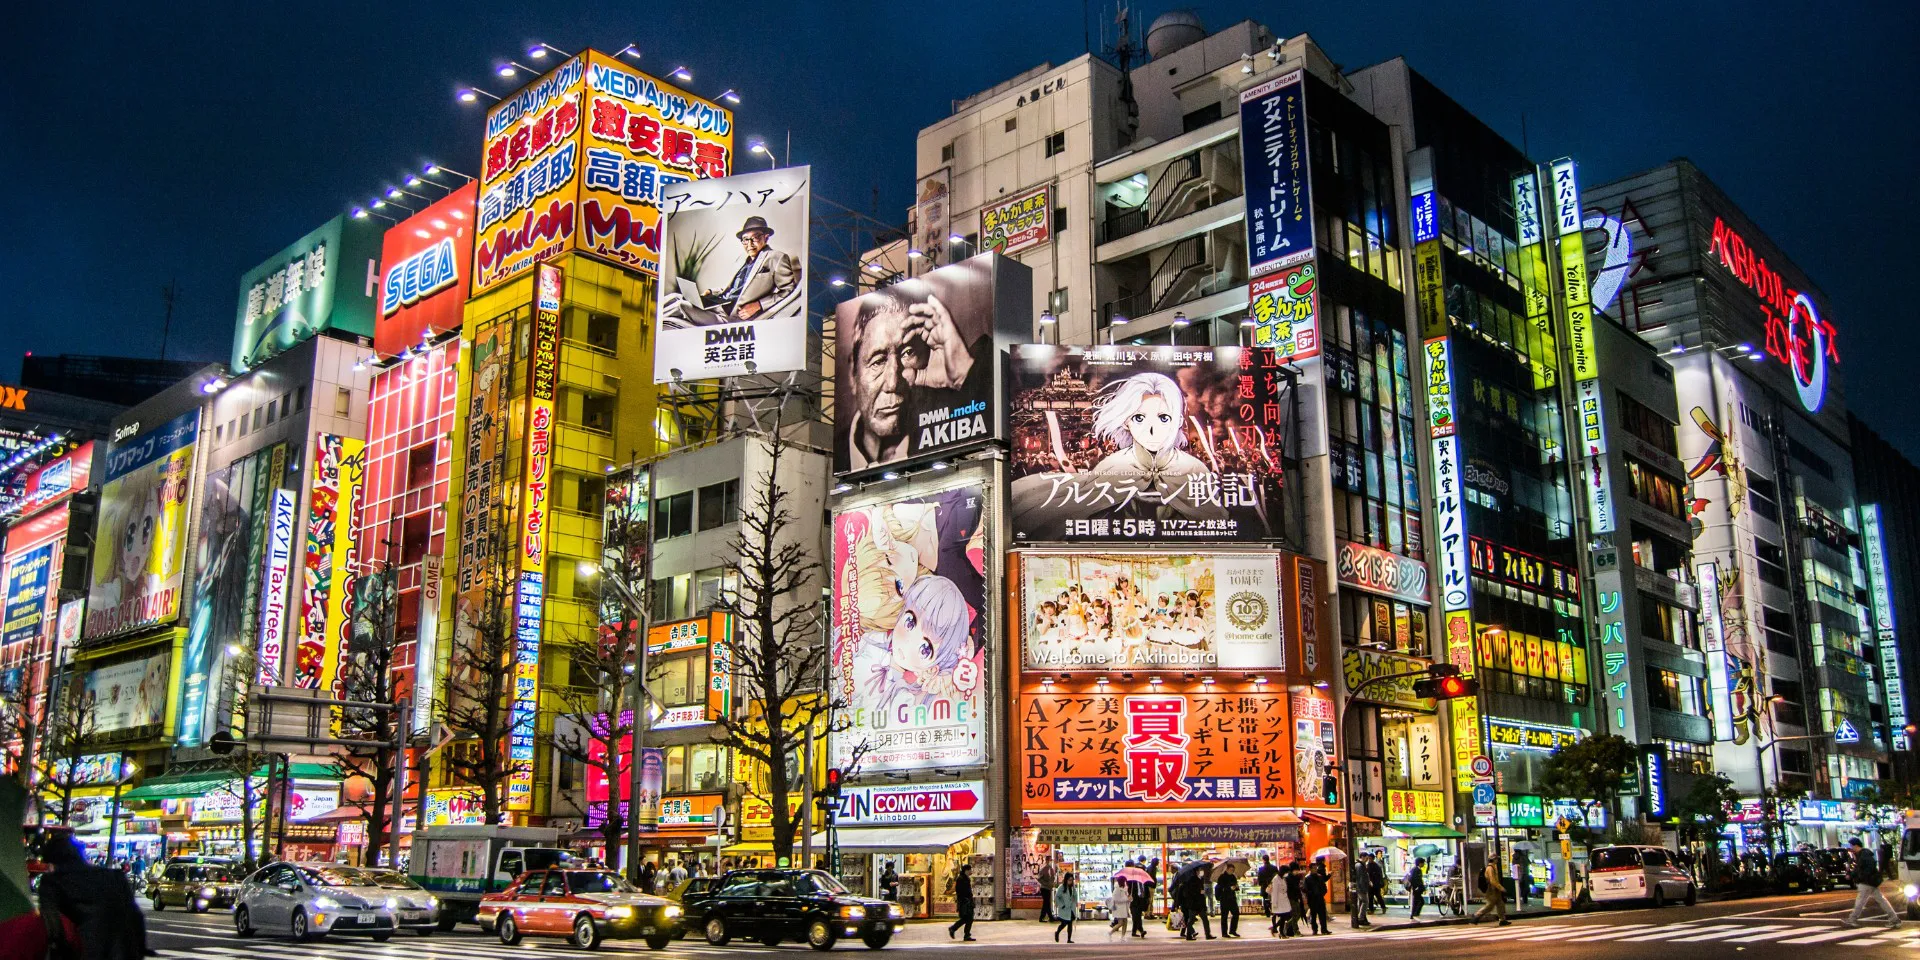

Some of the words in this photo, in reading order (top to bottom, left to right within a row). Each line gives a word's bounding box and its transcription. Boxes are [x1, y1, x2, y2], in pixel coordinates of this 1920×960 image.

[489, 57, 584, 139] MEDIAリサイクル
[593, 65, 729, 134] MEDIAリサイクル
[1243, 83, 1271, 100] AMENITY
[1274, 73, 1298, 89] DREAM
[485, 100, 579, 182] 激安販売
[592, 98, 727, 180] 激安販売
[480, 143, 575, 233] 高額買取
[1262, 95, 1291, 252] アメニティードリーム
[984, 192, 1046, 232] まんが喫茶
[1557, 169, 1576, 228] スーパービル
[511, 251, 533, 272] AKIBA
[597, 243, 641, 267] ムーラン
[1254, 260, 1283, 275] AMENITY
[1286, 252, 1311, 265] DREAM
[383, 237, 459, 315] SEGA
[1566, 264, 1579, 302] Yellow
[540, 311, 557, 323] DVD
[1253, 293, 1314, 323] まんが
[540, 341, 553, 351] CD
[705, 325, 756, 346] DMM
[1255, 321, 1292, 345] 喫茶
[1299, 337, 1314, 349] 3F
[1572, 311, 1587, 373] Submarine
[704, 343, 755, 364] 英会話
[1428, 341, 1446, 385] まんが
[1581, 380, 1593, 390] 5F
[919, 399, 986, 427] DMM.make
[918, 414, 988, 450] AKIBA
[1039, 471, 1258, 513] アルスラーン戦記
[1346, 464, 1362, 487] 5F
[246, 454, 268, 581] メロンブックス
[276, 493, 292, 549] AKKY
[1075, 519, 1110, 536] 日曜
[1123, 519, 1156, 536] 5時
[1161, 519, 1238, 530] TVアニメ放送中
[426, 560, 439, 600] GAME
[1338, 545, 1428, 597] メイドカジノ
[1503, 551, 1545, 588] フィギュア
[133, 596, 151, 622] ON
[151, 587, 176, 620] AIR!
[265, 564, 287, 640] Tax-free
[1255, 632, 1273, 640] cafe
[1032, 649, 1107, 665] Welcome
[1111, 650, 1128, 665] to
[1132, 648, 1218, 665] Akihabara
[1307, 645, 1314, 666] 入口
[1600, 591, 1628, 728] リバティー
[897, 695, 978, 726] GAME!
[1076, 698, 1097, 753] アニメ
[1214, 697, 1236, 753] ホビー
[511, 736, 522, 745] B1F
[1024, 698, 1051, 799] AKBもの
[1054, 698, 1075, 773] アイドル
[1097, 697, 1121, 776] 美少女系
[1126, 699, 1188, 799] 買取
[1193, 698, 1214, 776] フィギュア
[1237, 697, 1261, 776] 携帯電話
[1260, 698, 1285, 800] アップルとか
[1420, 735, 1432, 781] ルノアール
[1475, 760, 1488, 772] 40
[314, 795, 333, 803] Japan
[510, 784, 531, 793] AKIBA
[1056, 780, 1122, 799] チケット
[1193, 779, 1258, 799] 大黒屋
[1478, 789, 1487, 803] P
[1647, 753, 1661, 814] GALLERIA
[873, 814, 917, 822] Akihabara
[874, 794, 926, 813] COMIC
[928, 793, 951, 811] ZIN
